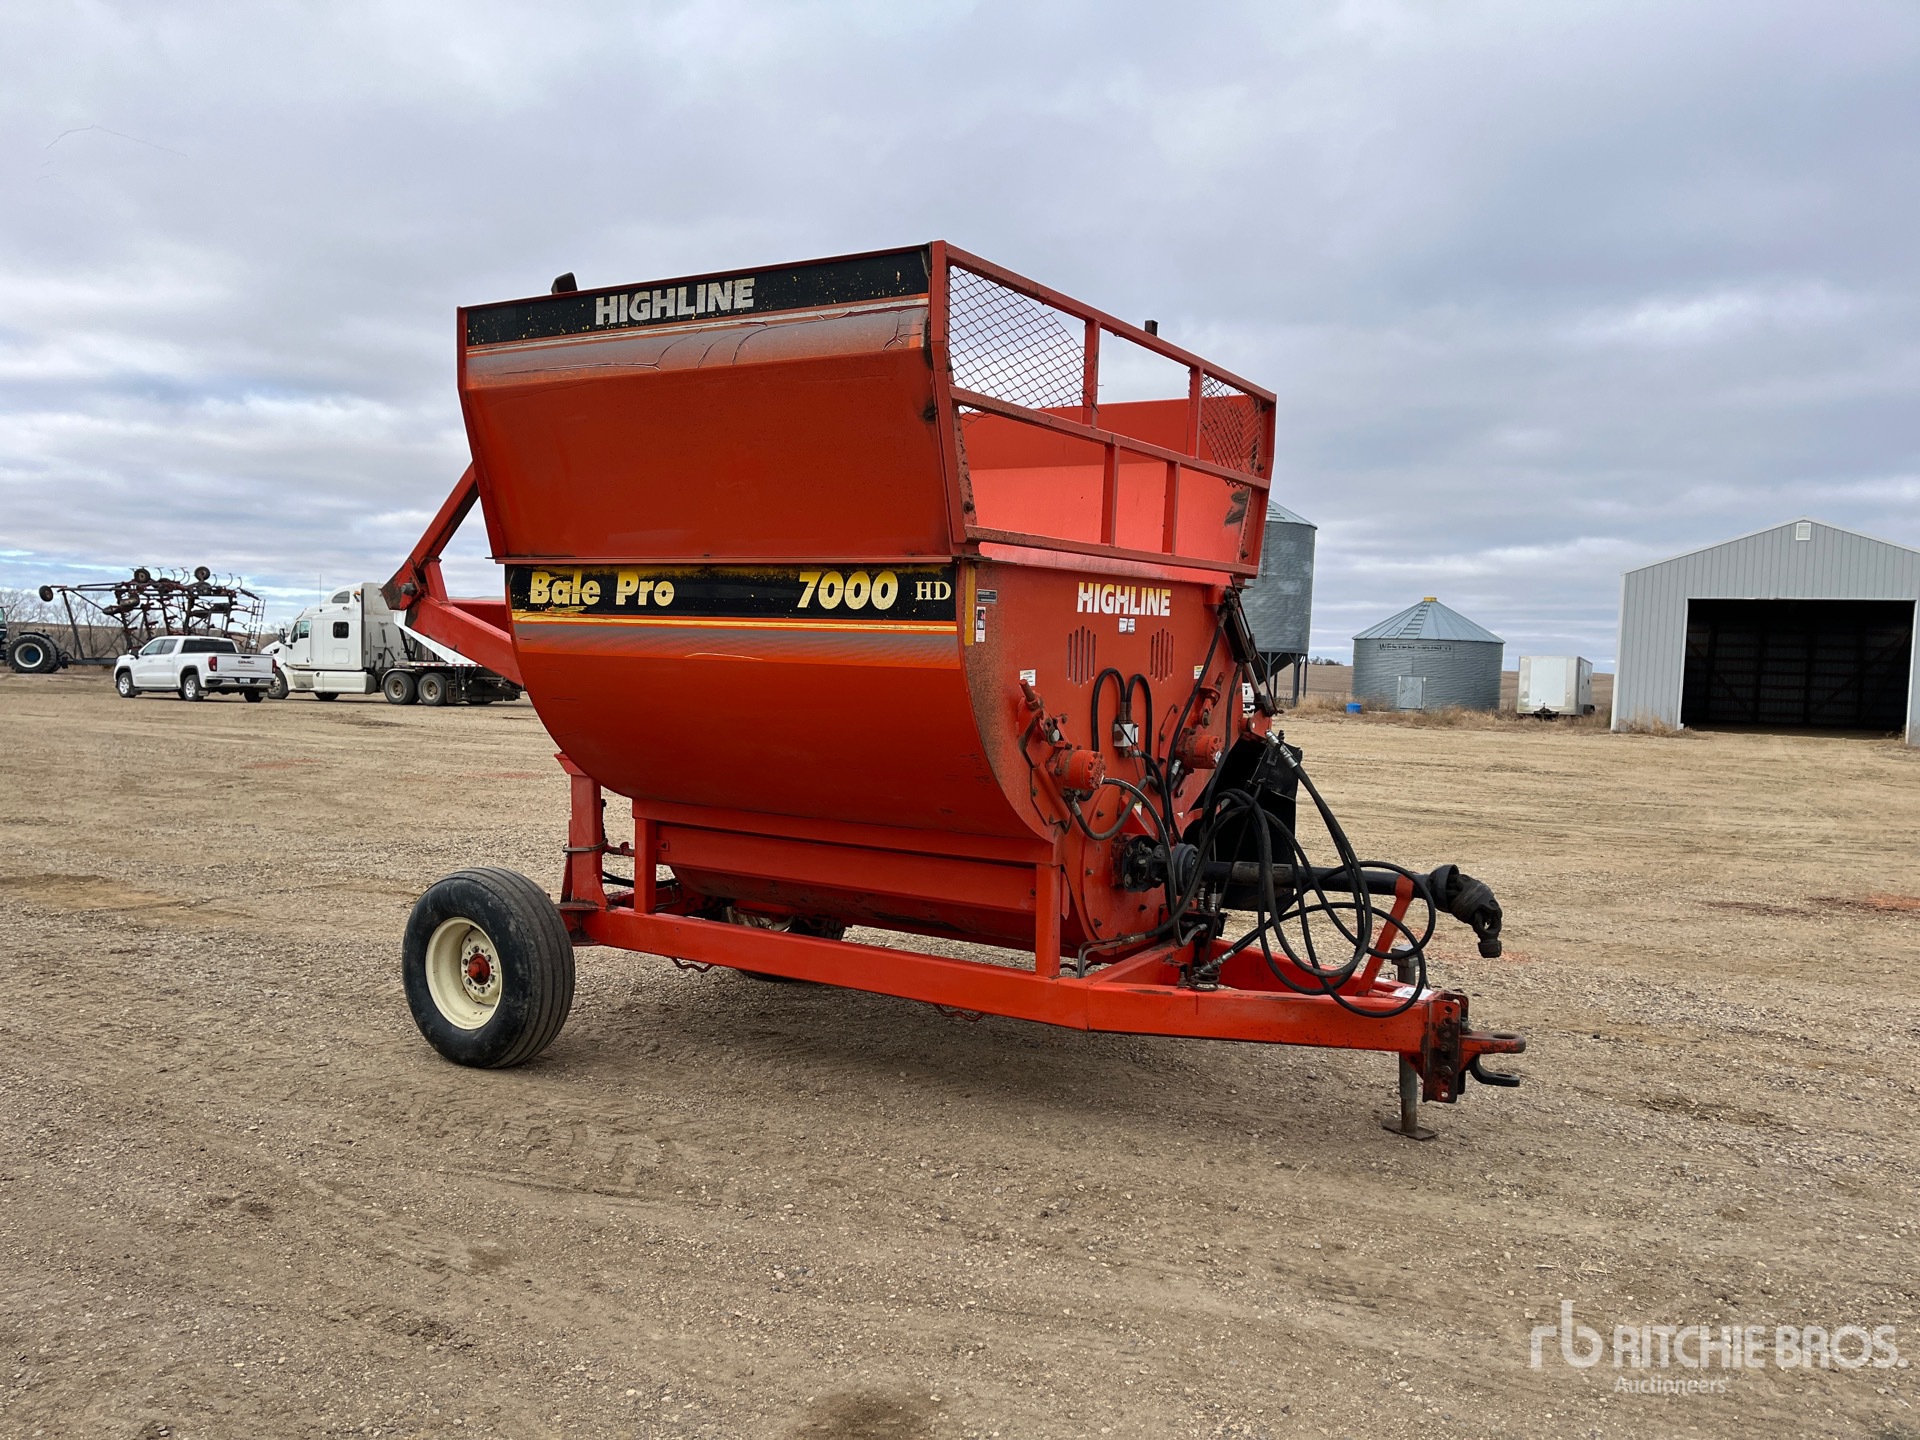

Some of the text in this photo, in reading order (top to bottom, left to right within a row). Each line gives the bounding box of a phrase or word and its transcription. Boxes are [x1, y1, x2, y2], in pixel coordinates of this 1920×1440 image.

[595, 277, 756, 326] HIGHLINE
[530, 569, 952, 610] Bale Pro 7000 HD
[1077, 581, 1171, 616] HIGHLINE
